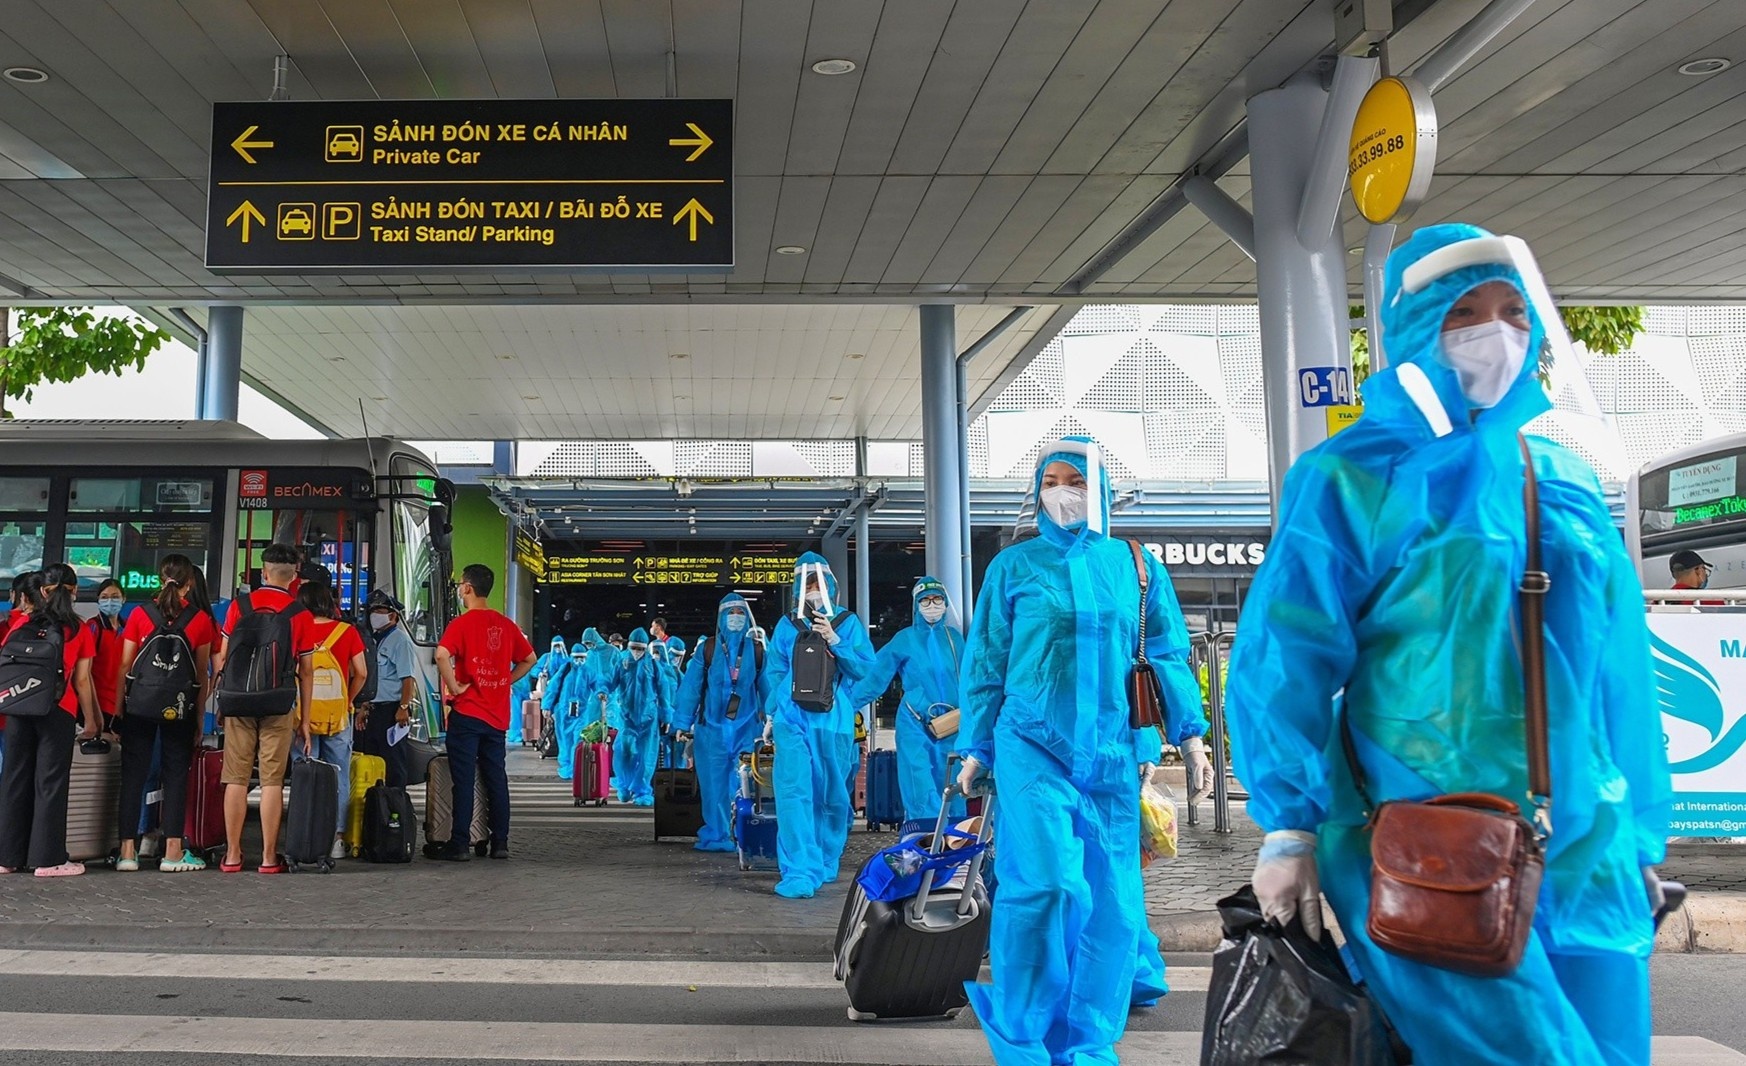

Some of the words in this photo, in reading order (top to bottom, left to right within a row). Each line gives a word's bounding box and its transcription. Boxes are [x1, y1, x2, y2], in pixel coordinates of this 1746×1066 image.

[374, 120, 434, 142] SẢNH
[442, 121, 490, 142] ĐÓN
[497, 124, 526, 141] XE
[533, 122, 561, 141] CÁ
[569, 121, 627, 141] NHÂN
[373, 149, 440, 164] Private
[446, 149, 480, 164] Car
[371, 196, 430, 219] SẢNH
[438, 198, 485, 218] ĐÓN
[491, 201, 540, 218] TAXI
[545, 201, 554, 218] /
[559, 199, 594, 218] BÃI
[600, 195, 630, 218] ĐỖ
[636, 202, 663, 218] XE
[370, 225, 409, 242] Taxi
[415, 225, 477, 242] Stand/
[482, 225, 555, 245] Parking
[1302, 371, 1348, 403] C-14
[274, 482, 342, 497] BECAMEX
[240, 498, 268, 508] V1408
[1676, 503, 1722, 523] Becamex
[1720, 640, 1746, 658] M
